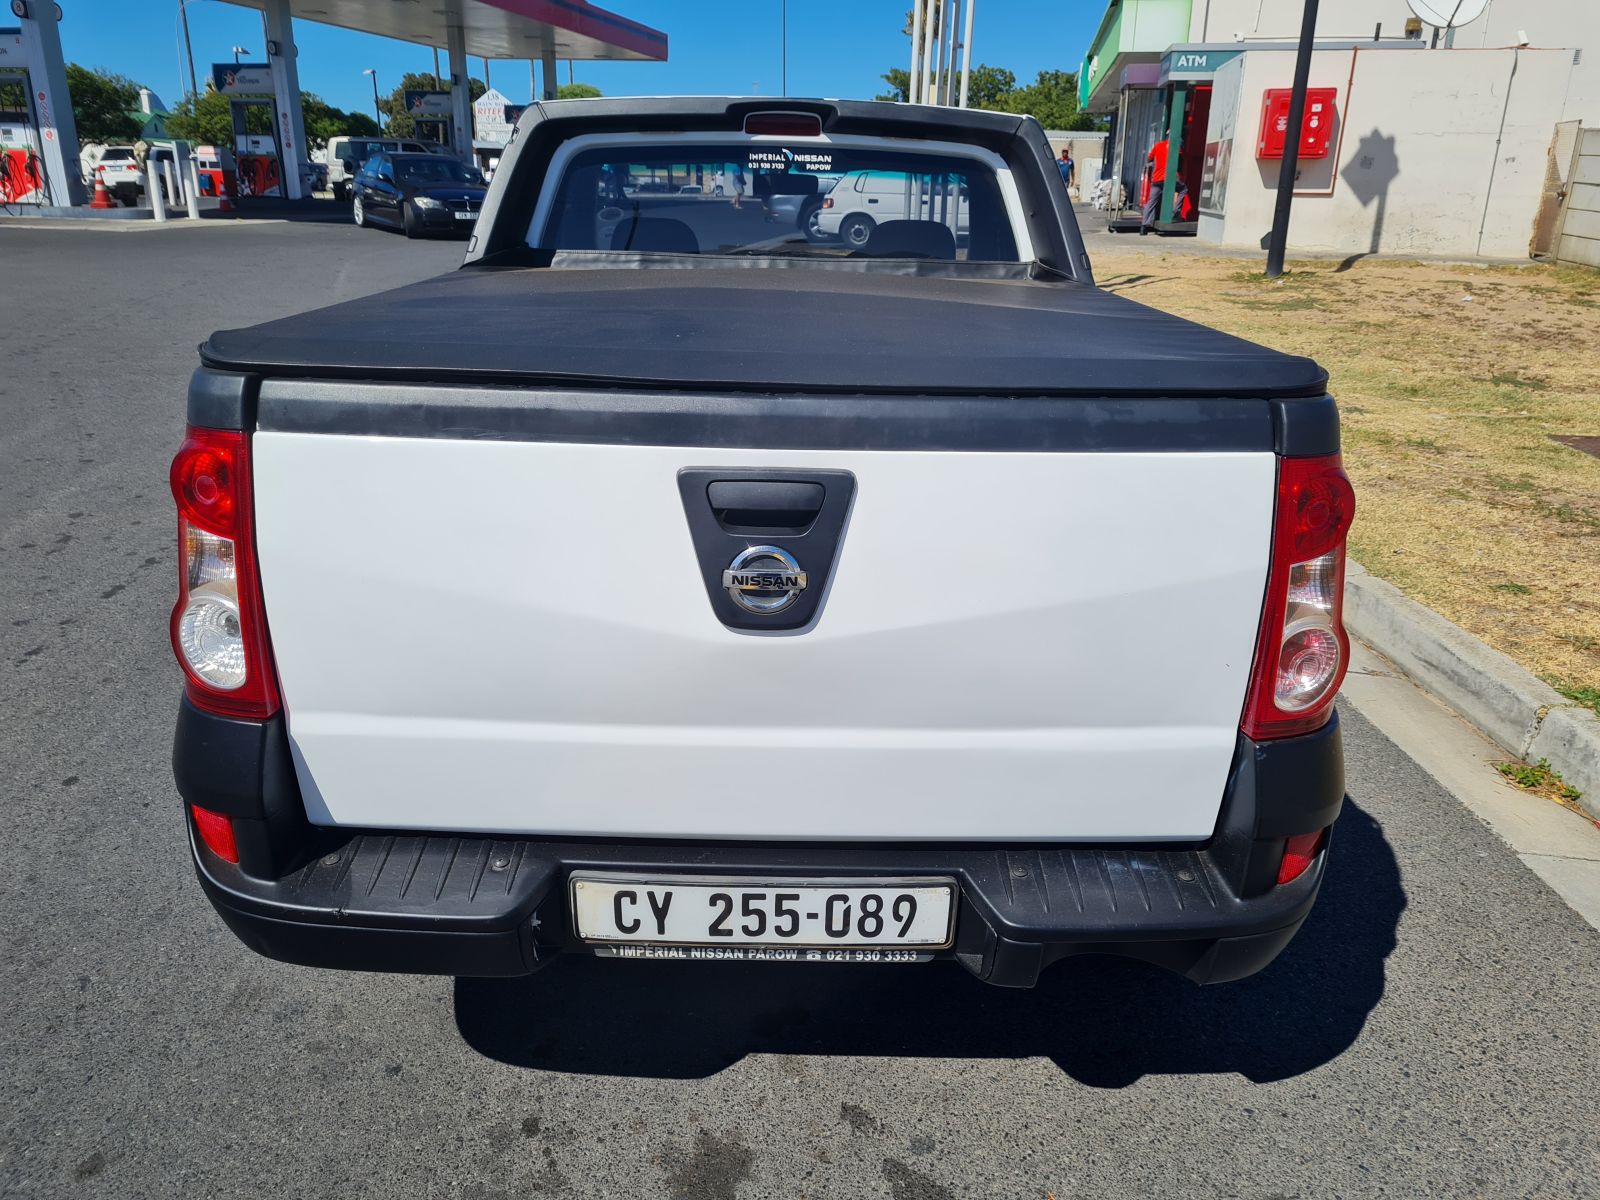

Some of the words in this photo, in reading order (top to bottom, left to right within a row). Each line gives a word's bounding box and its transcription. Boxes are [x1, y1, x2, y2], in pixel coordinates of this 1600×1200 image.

[1177, 55, 1207, 67] ATM
[749, 153, 786, 161] IMPERIAL
[731, 575, 798, 588] NISSAN
[614, 890, 673, 935] CY
[709, 892, 917, 938] 255-089
[619, 946, 686, 958] IMPERIAL
[690, 948, 743, 959] NISSAN
[748, 949, 798, 960] PAROW
[826, 951, 850, 961] 021
[855, 951, 880, 961] 930
[884, 951, 917, 961] 3333
